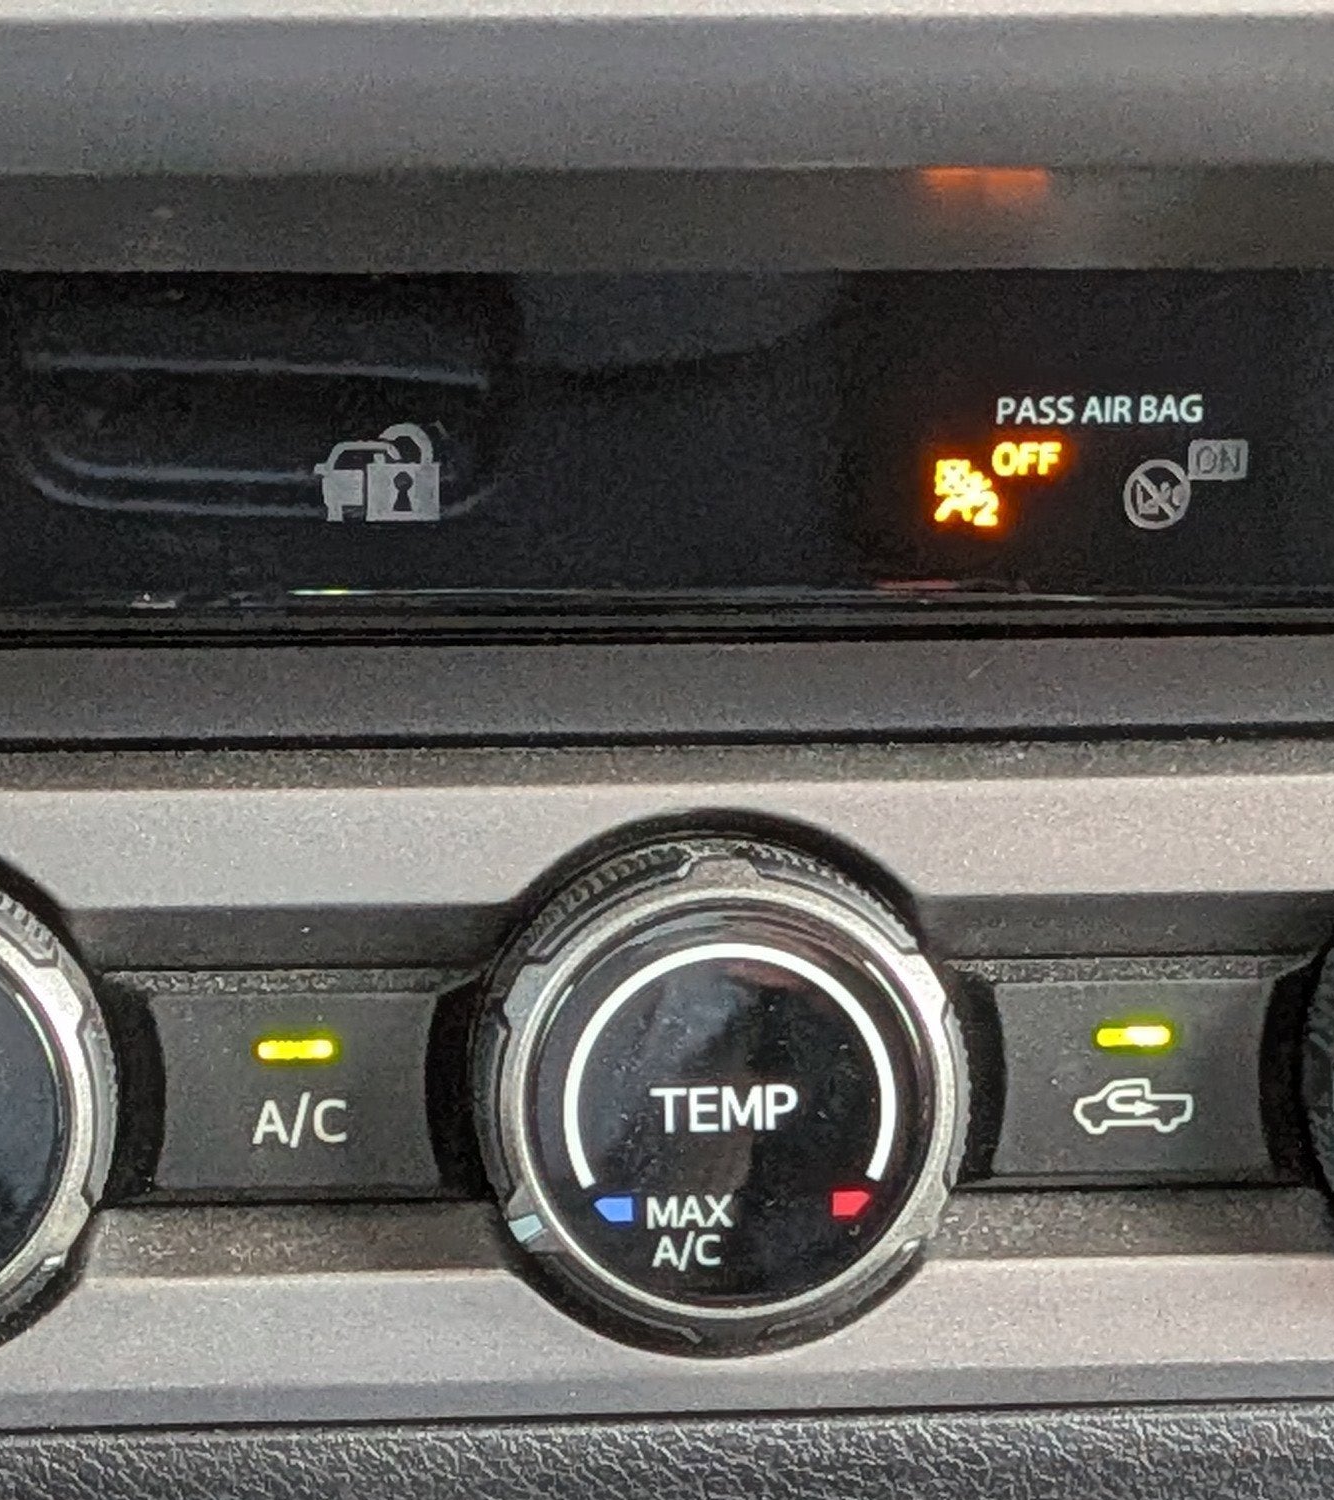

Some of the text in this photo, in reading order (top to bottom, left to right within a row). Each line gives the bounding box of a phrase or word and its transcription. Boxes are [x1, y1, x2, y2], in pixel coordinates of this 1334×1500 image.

[996, 393, 1204, 425] PASS AIR BAG
[991, 441, 1063, 477] OFF
[1194, 444, 1243, 475] ON
[252, 1091, 348, 1148] A/C
[650, 1084, 798, 1132] TEMP
[646, 1195, 734, 1229] MAX
[652, 1233, 722, 1272] A/C
